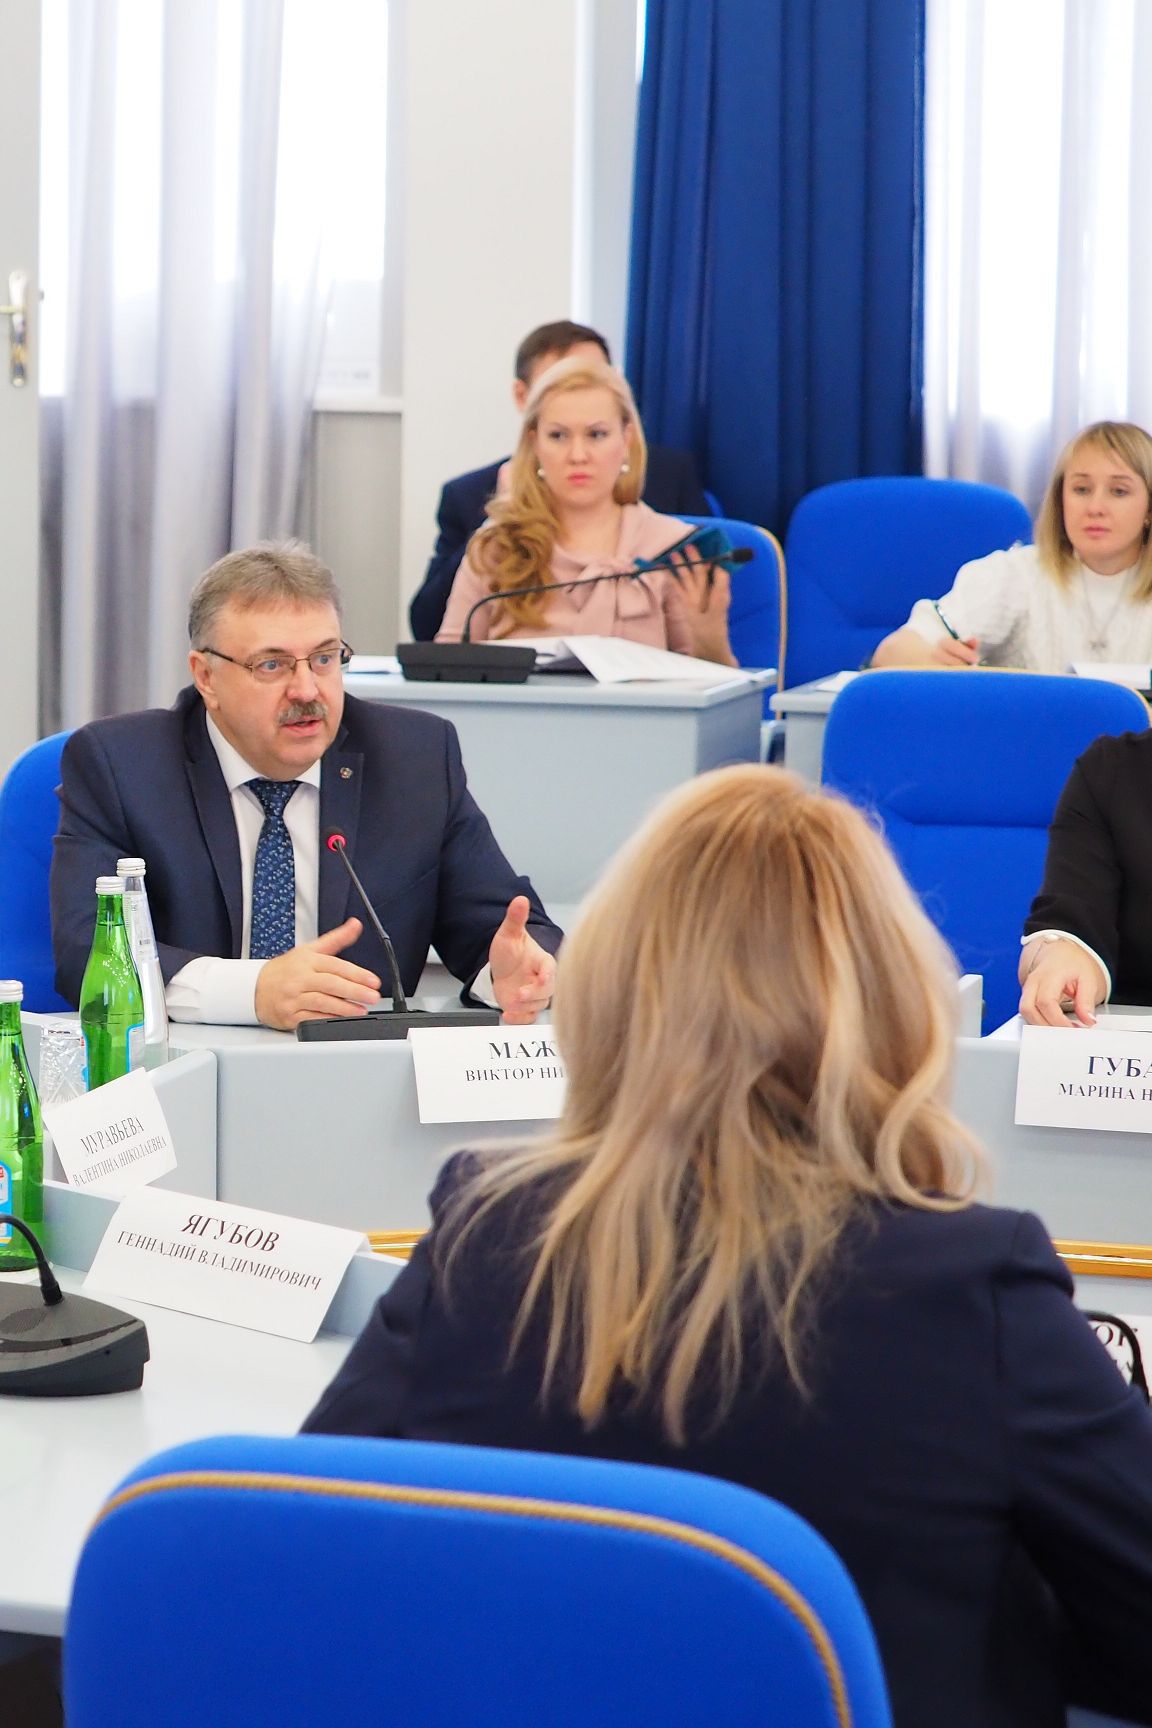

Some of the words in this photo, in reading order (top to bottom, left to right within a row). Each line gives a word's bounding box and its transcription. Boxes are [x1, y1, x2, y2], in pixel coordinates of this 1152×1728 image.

[465, 1067, 535, 1082] ВИКТОР
[1058, 1083, 1135, 1101] МАРИНА
[79, 1116, 145, 1158] МУРАВЬЕВА
[72, 1157, 120, 1188] ВАЛЕНТИНА
[117, 1135, 168, 1166] НИКОЛАЕВНА
[179, 1213, 281, 1253] ЯГУБОВ
[116, 1230, 198, 1261] ГЕННАДИЙ
[197, 1249, 323, 1291] ВЛАДИМИРОВИЧ
